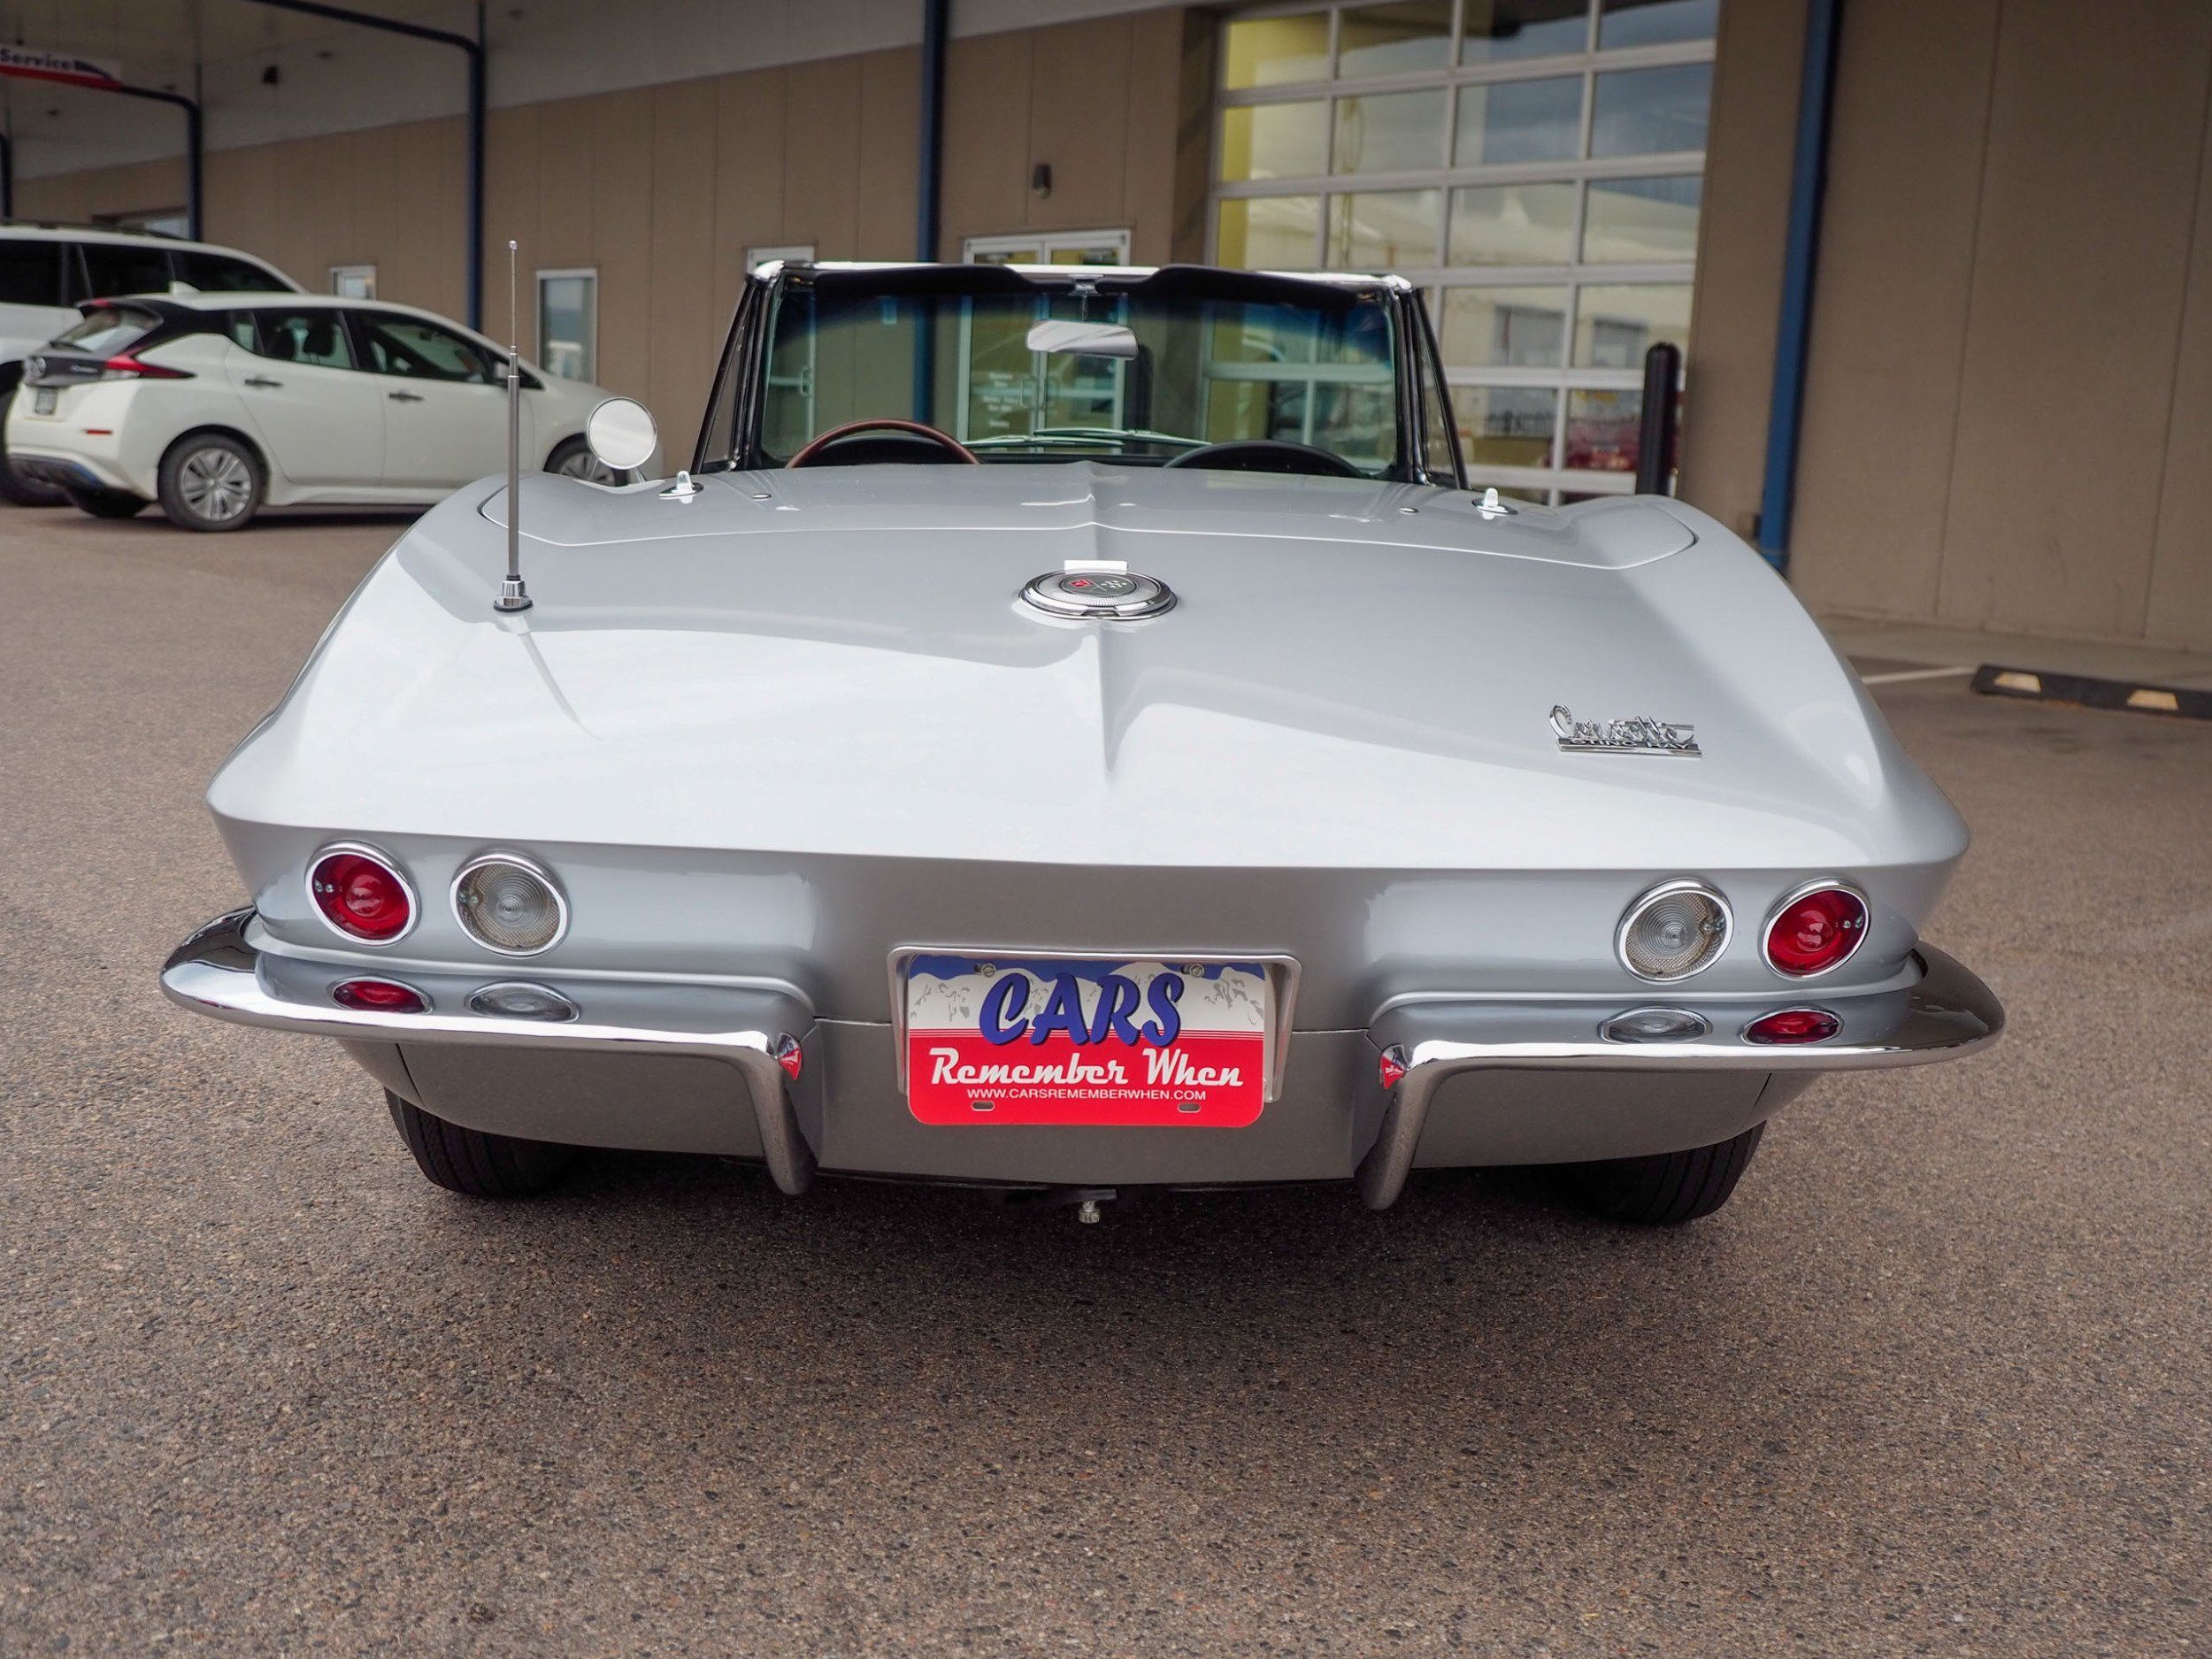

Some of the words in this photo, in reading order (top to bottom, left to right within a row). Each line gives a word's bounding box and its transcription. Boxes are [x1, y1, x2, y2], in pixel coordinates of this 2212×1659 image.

[0, 48, 71, 70] Service
[979, 972, 1185, 1047] CARS
[929, 1047, 1129, 1085] Remember
[1142, 1048, 1244, 1087] When
[967, 1088, 1206, 1101] WWW.CARSREMEMBERWHEN.COM
